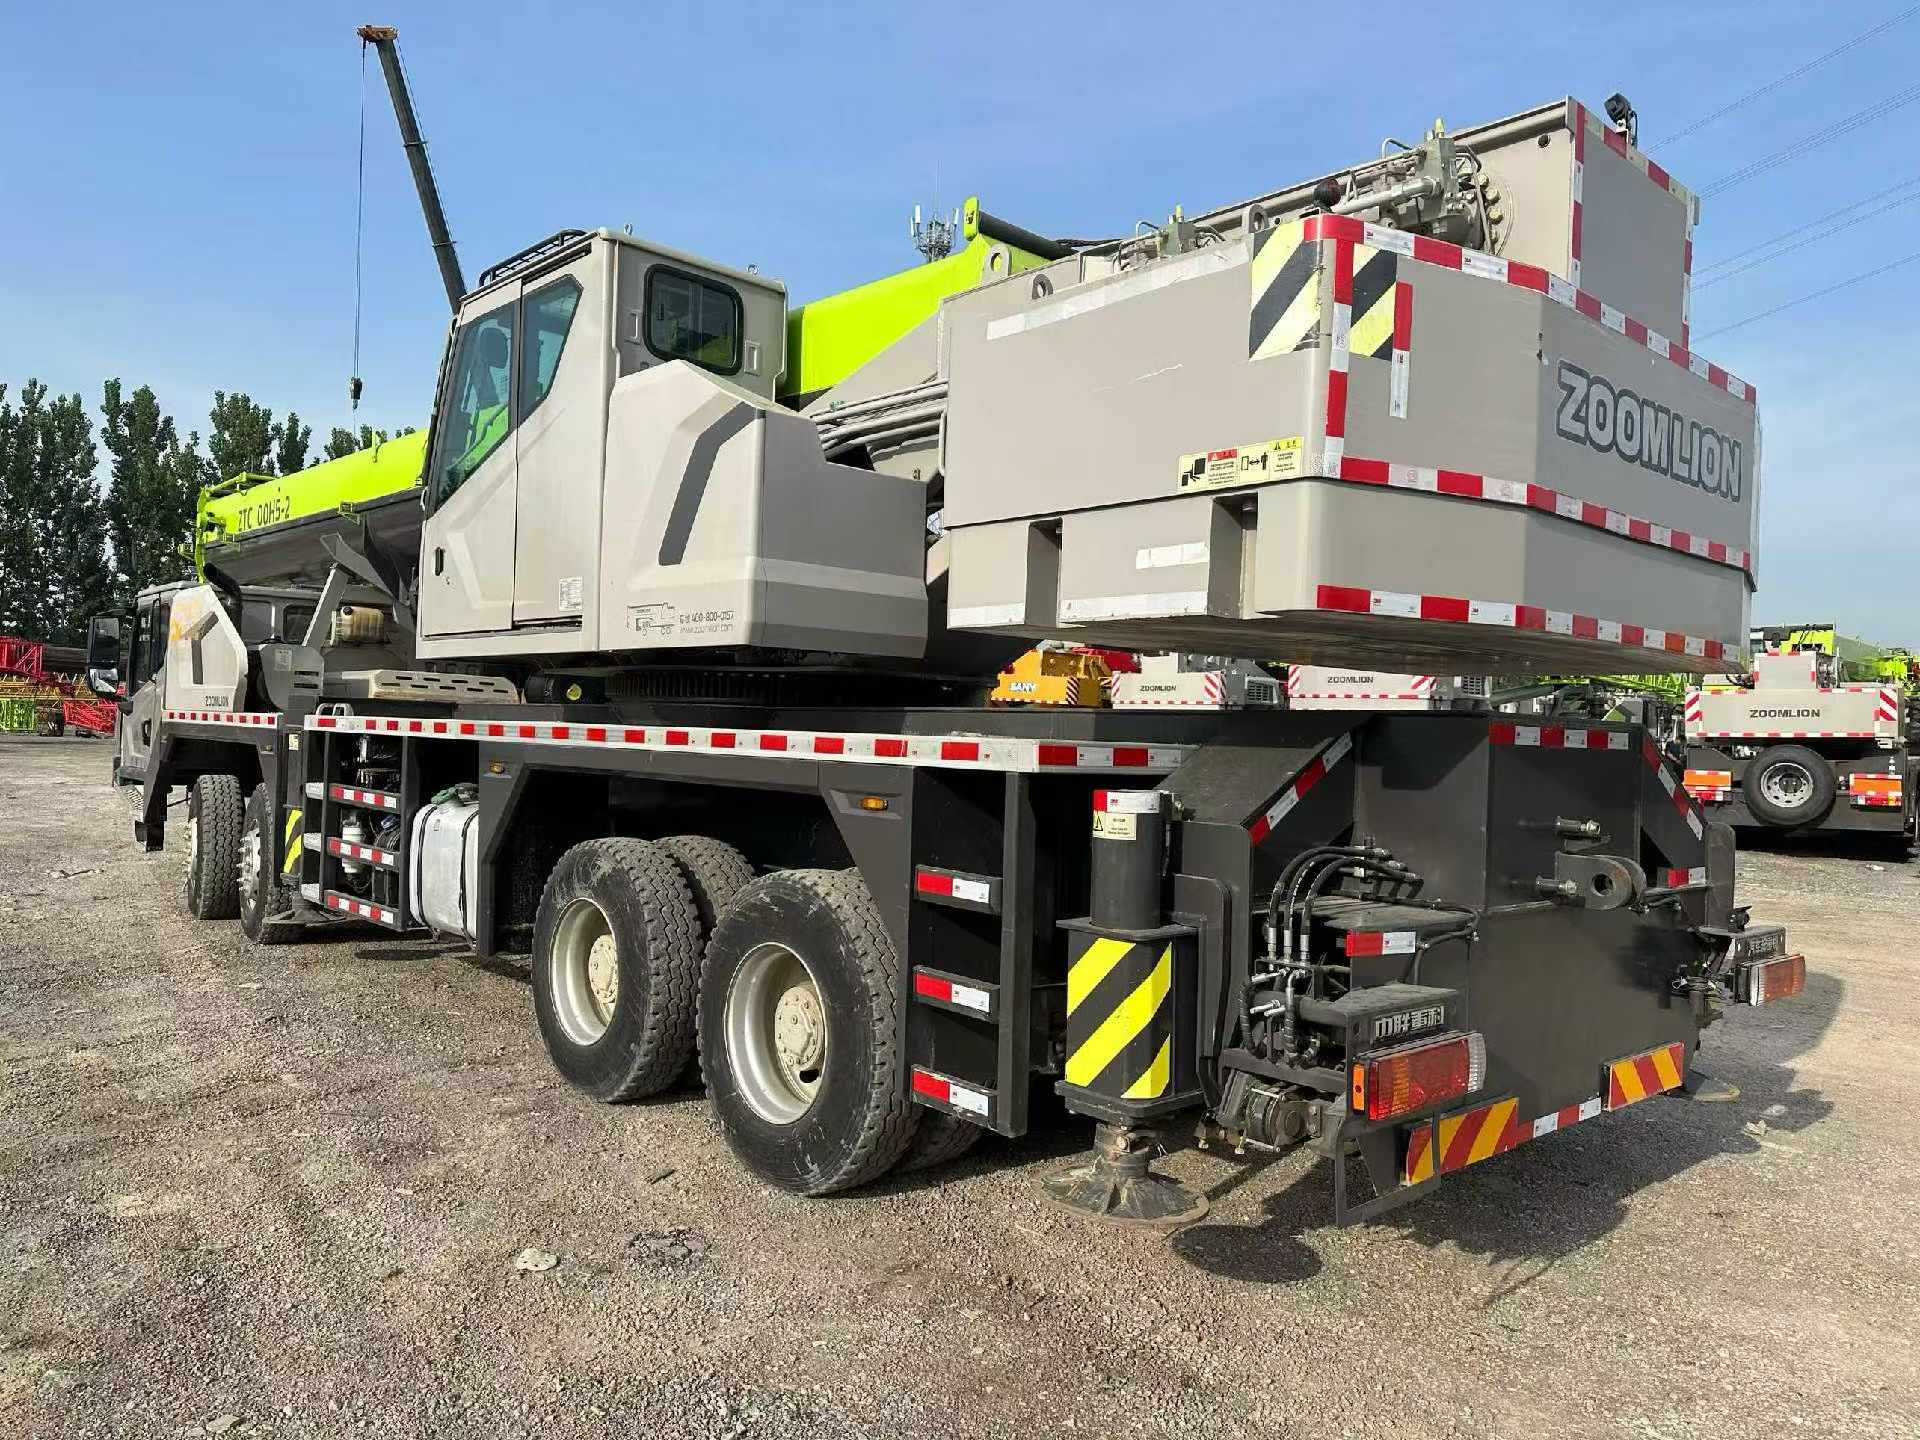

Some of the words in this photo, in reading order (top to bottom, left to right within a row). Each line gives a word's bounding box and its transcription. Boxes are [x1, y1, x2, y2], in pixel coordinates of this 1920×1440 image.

[1557, 359, 1743, 503] ZOOMLION
[238, 507, 253, 532] ZTC
[1010, 682, 1037, 693] SANY
[1327, 676, 1374, 684] ZOOMLION
[1749, 709, 1821, 718] ZOOMLION
[1375, 1005, 1445, 1038] 中联重科
